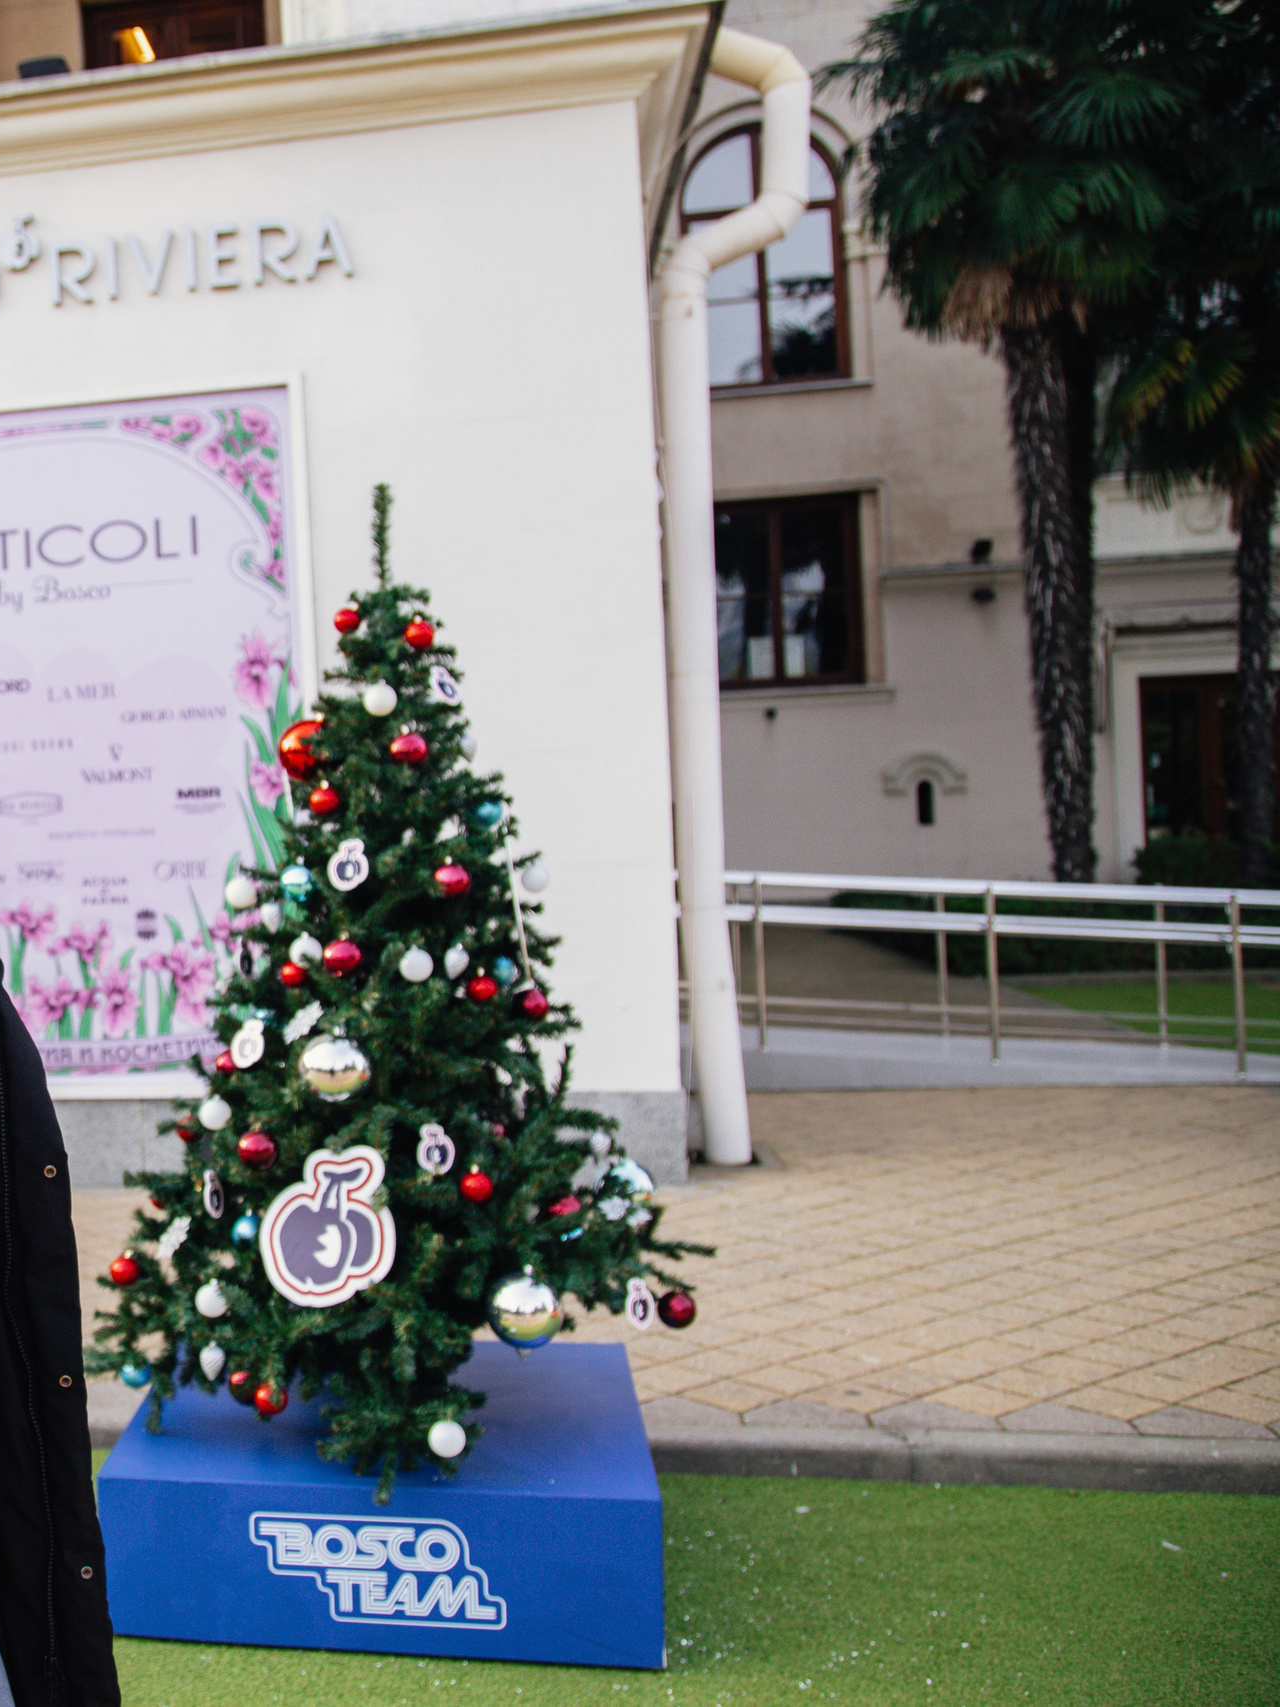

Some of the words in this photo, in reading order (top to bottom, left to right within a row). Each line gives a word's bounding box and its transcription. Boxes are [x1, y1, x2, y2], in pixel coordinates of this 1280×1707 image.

[52, 213, 355, 307] RIVIERA
[33, 574, 112, 604] Bosco
[47, 685, 72, 703] LA
[76, 682, 117, 700] MER
[120, 708, 175, 724] GIORGIO
[178, 704, 227, 721] ARMANI
[80, 767, 154, 784] VALMONT
[80, 1046, 94, 1063] И
[258, 1520, 461, 1573] BOSCO
[325, 1568, 498, 1621] TEAM
